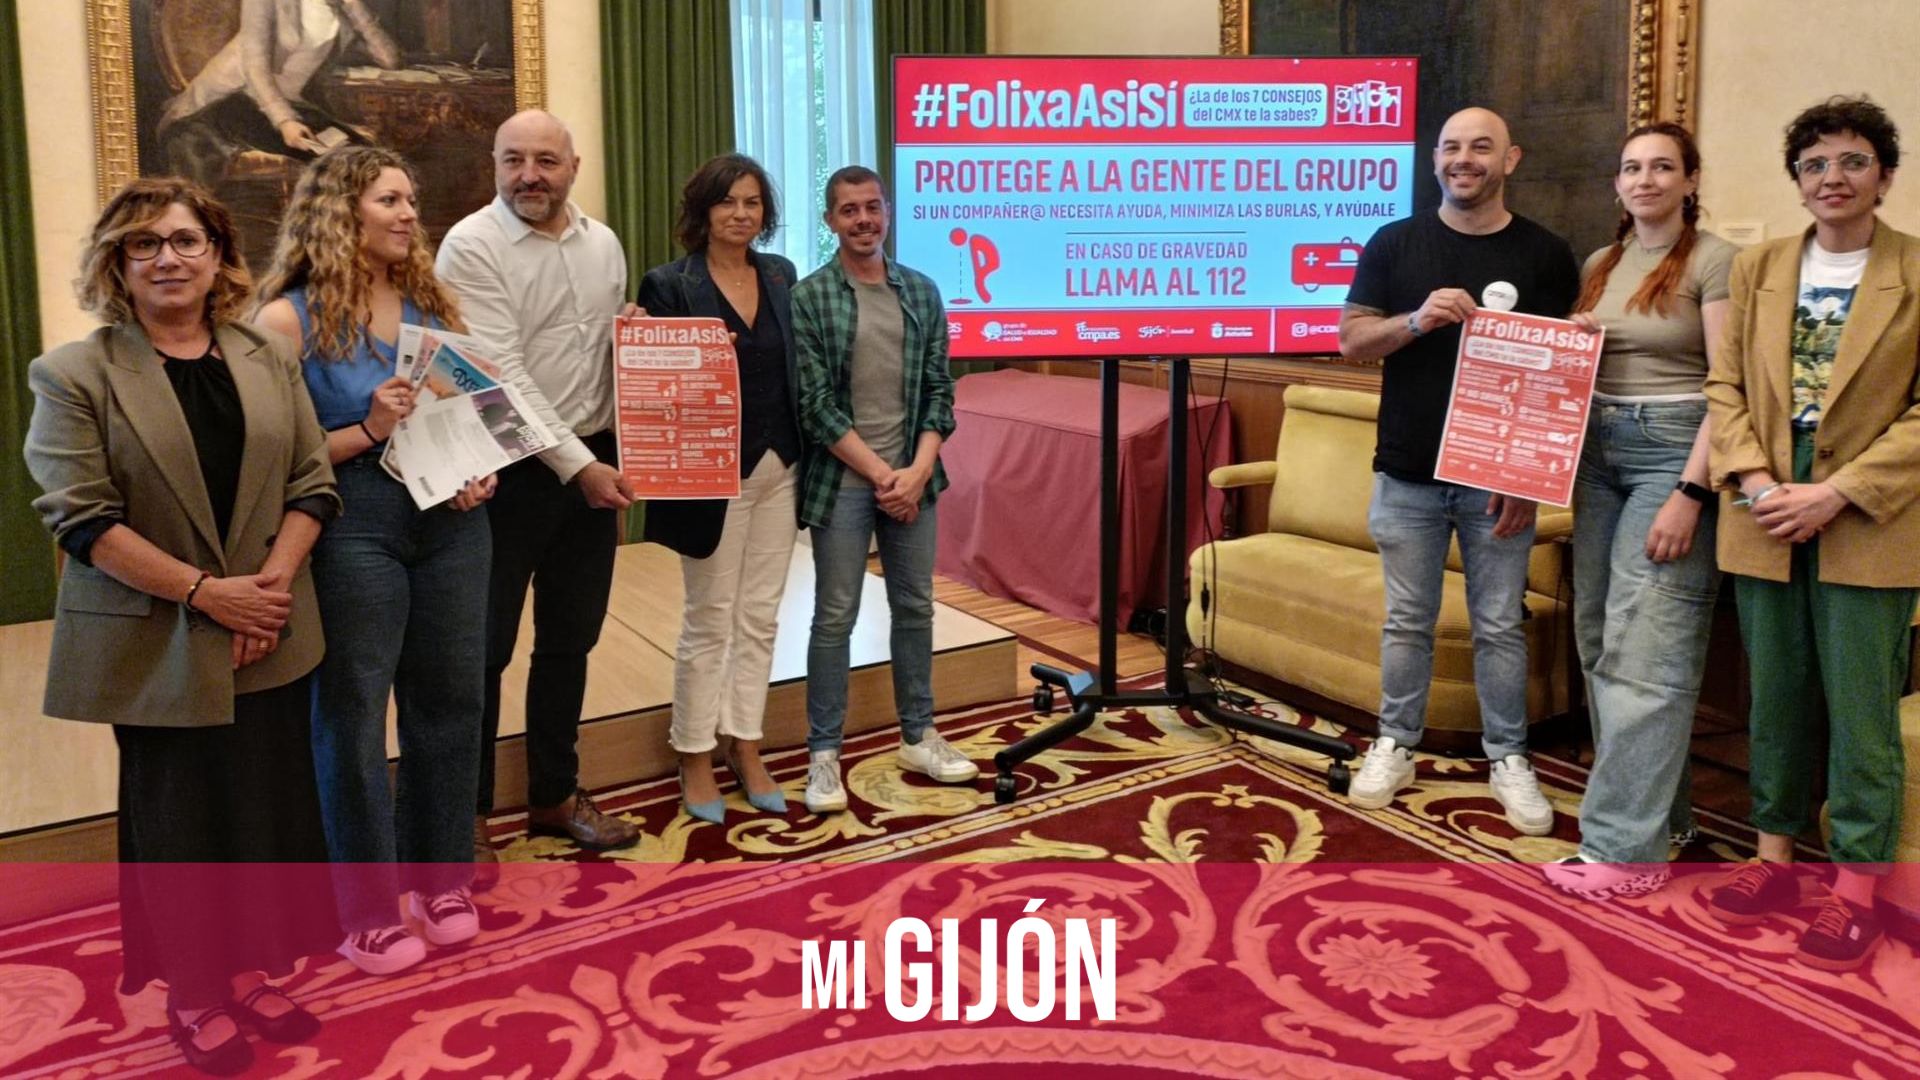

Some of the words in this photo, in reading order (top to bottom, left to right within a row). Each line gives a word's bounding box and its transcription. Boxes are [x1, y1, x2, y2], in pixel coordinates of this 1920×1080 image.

[912, 79, 1178, 128] #FolixaAsiSí
[1189, 89, 1210, 105] ¿La
[1213, 90, 1227, 103] de
[1231, 89, 1250, 103] los
[1253, 90, 1259, 103] 7
[1262, 90, 1322, 104] CONSEJOS
[1193, 108, 1212, 121] del
[1215, 108, 1241, 121] CMX
[1245, 108, 1256, 121] te
[1259, 108, 1271, 121] la
[1273, 108, 1317, 121] sabes?
[915, 159, 1051, 193] PROTEGE
[1059, 159, 1079, 193] A
[1088, 159, 1122, 193] LA
[1131, 159, 1226, 192] GENTE
[1234, 159, 1288, 192] DEL
[1296, 158, 1397, 191] GRUPO
[913, 205, 926, 219] SI
[930, 205, 949, 219] UN
[952, 202, 1046, 221] COMPAÑER@
[1050, 204, 1113, 219] NECESITA
[1117, 204, 1167, 221] AYUDA,
[1170, 203, 1234, 218] MINIMIZA
[1238, 203, 1262, 218] LAS
[1266, 203, 1320, 219] BURLAS,
[1324, 203, 1332, 217] Y
[1335, 200, 1395, 217] AYÚDALE
[1066, 243, 1086, 259] EN
[1091, 243, 1133, 259] CASO
[1138, 243, 1158, 259] DE
[1162, 242, 1247, 258] GRAVEDAD
[1066, 268, 1158, 296] LLAMA
[1166, 267, 1200, 295] AL
[1206, 267, 1246, 295] 112
